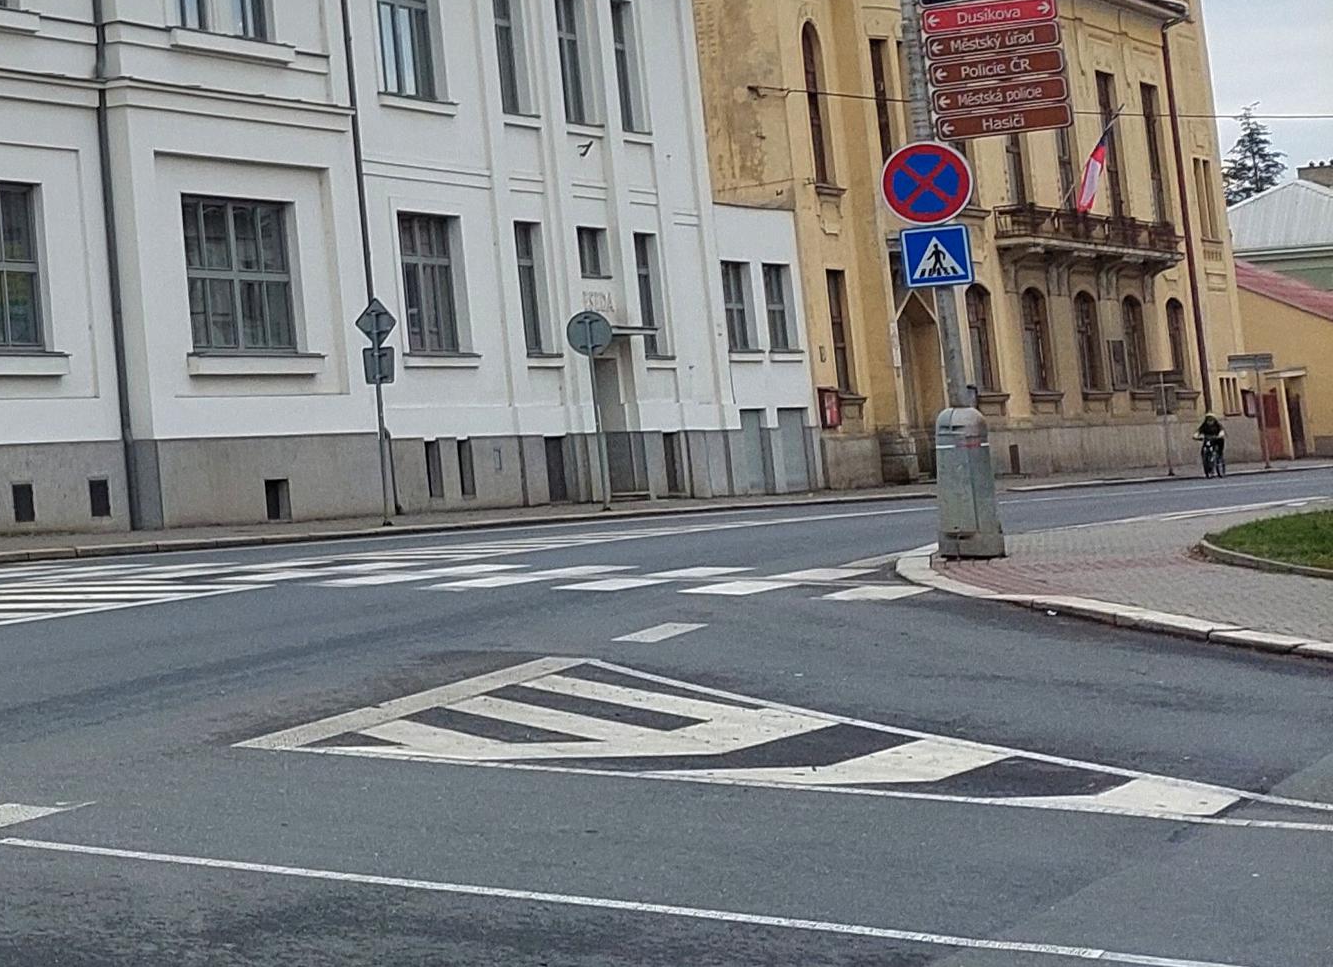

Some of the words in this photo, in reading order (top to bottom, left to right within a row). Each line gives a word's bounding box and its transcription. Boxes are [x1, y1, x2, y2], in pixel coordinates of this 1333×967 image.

[957, 7, 1021, 25] Dusíkova
[950, 33, 1002, 52] Městský
[1005, 29, 1035, 46] úřad
[960, 63, 1006, 79] Policie
[1010, 56, 1032, 72] ČR
[957, 88, 1003, 106] Městská
[1006, 86, 1043, 103] policie
[982, 114, 1025, 131] Hasiči
